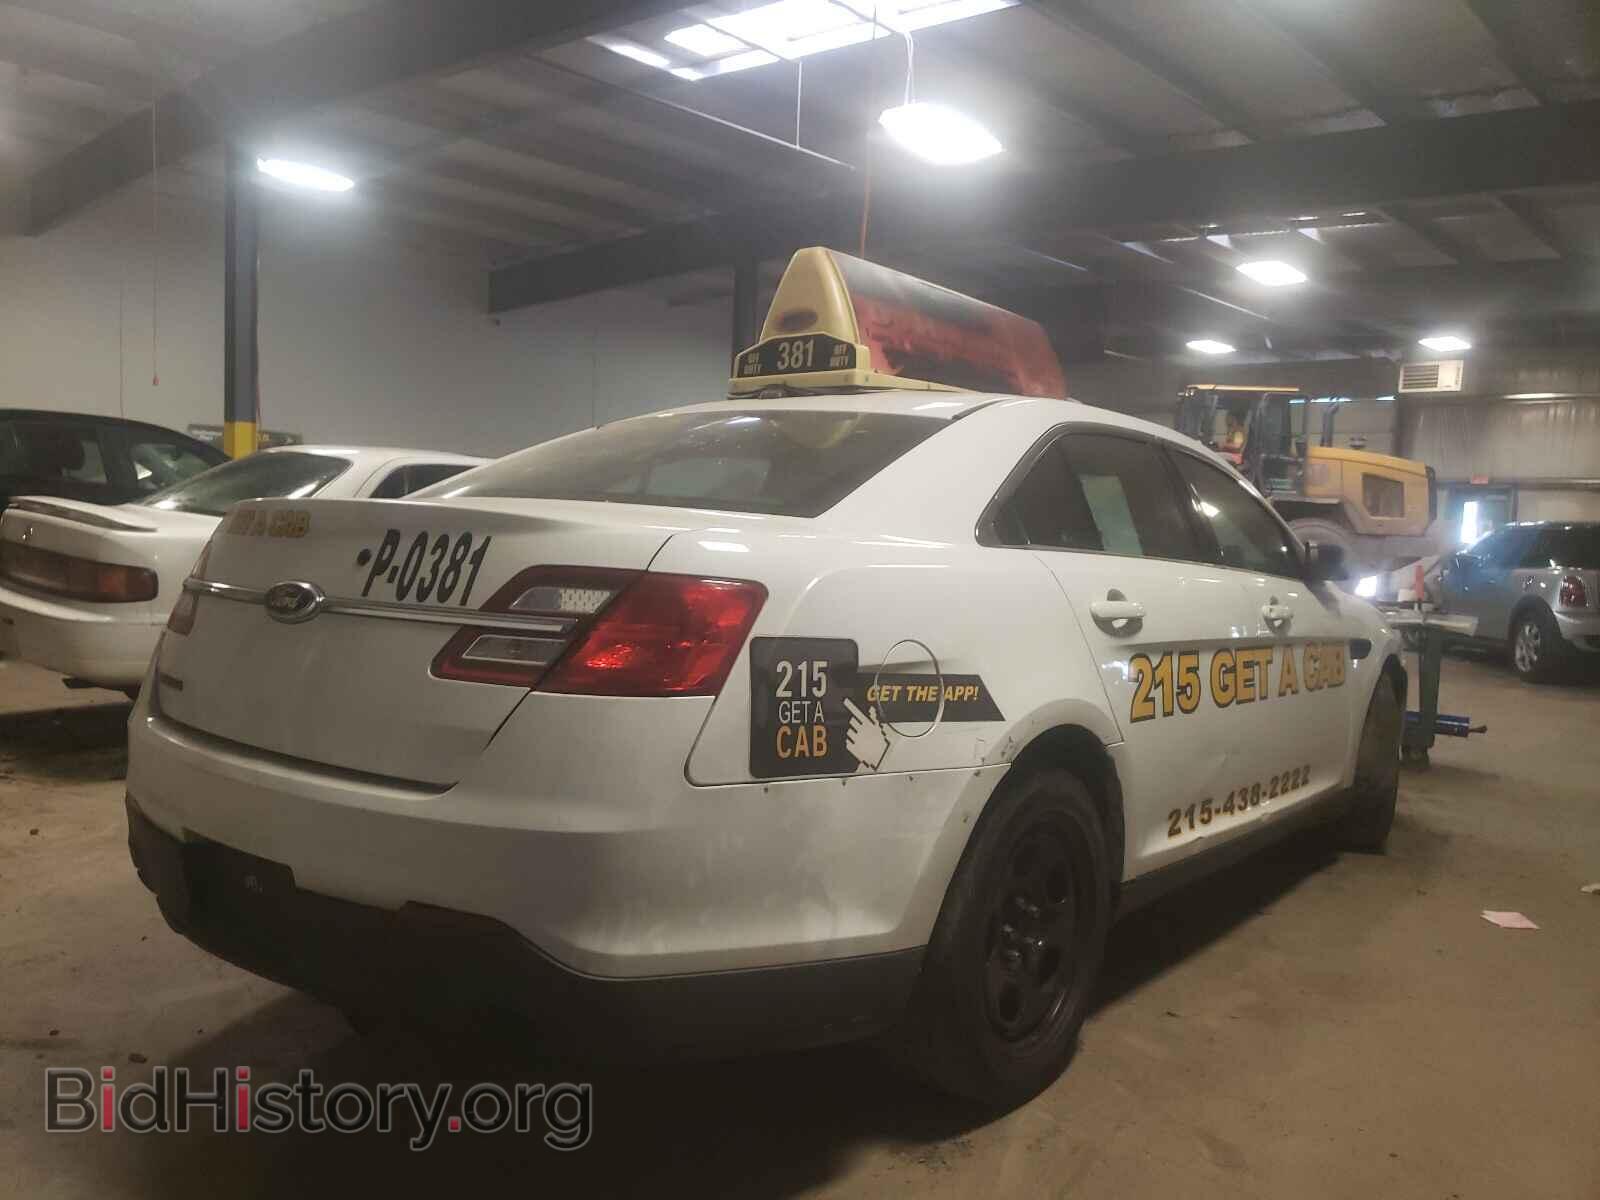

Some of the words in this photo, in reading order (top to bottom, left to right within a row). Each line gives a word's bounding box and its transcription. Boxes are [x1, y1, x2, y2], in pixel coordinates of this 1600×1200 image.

[776, 339, 815, 369] 381
[775, 660, 828, 698] 215
[866, 685, 901, 702] GET
[906, 685, 940, 702] THE
[943, 686, 979, 702] APP!
[1128, 650, 1201, 723] 215
[1209, 647, 1273, 708] GET
[1278, 645, 1299, 697] A
[1302, 641, 1346, 692] CAB
[778, 700, 811, 724] GET
[813, 700, 825, 723] A
[776, 725, 828, 758] CAB
[1167, 764, 1312, 838] 215-438-2222
